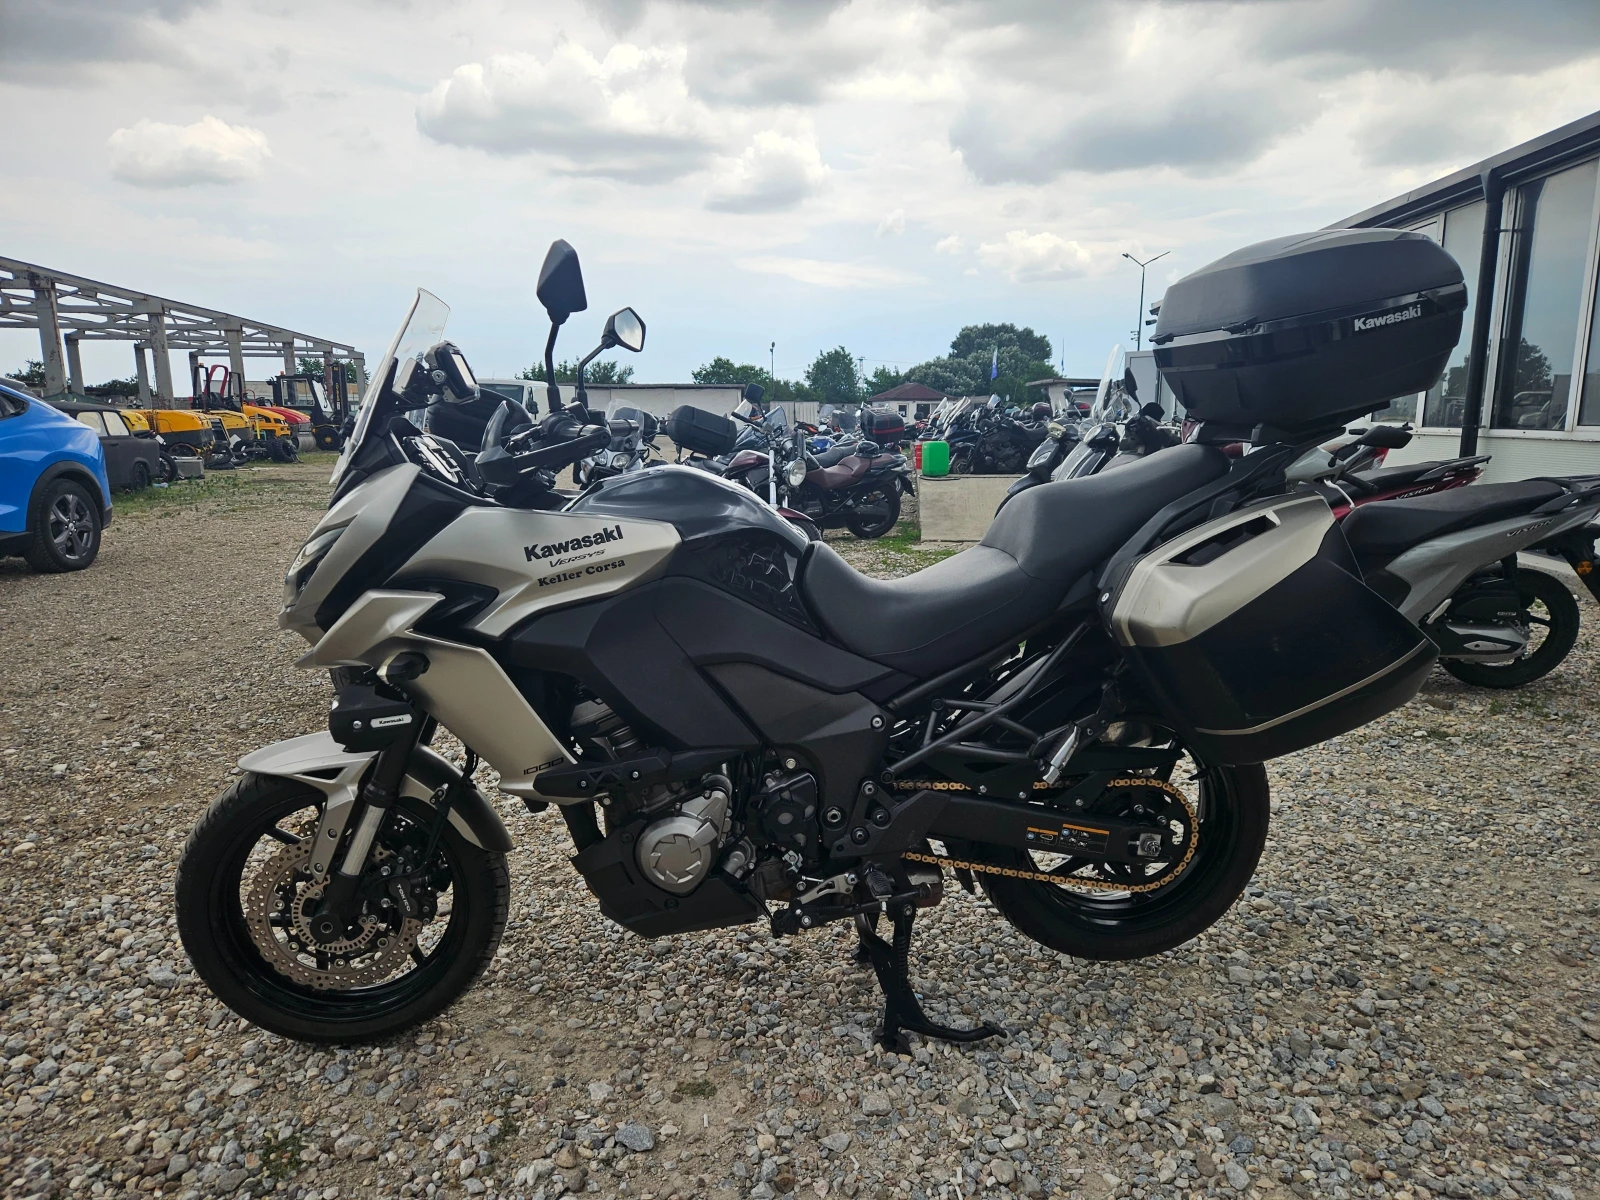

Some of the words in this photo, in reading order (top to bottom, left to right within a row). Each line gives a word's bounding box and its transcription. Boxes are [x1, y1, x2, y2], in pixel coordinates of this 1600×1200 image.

[1354, 304, 1421, 331] Kawasaki
[1506, 518, 1555, 537] VISION
[523, 524, 624, 562] Kawasaki
[537, 571, 582, 587] Keller
[585, 559, 626, 575] Corsa
[378, 717, 404, 725] Kawasaki
[523, 757, 564, 775] 1000
[396, 883, 411, 912] TOKICO
